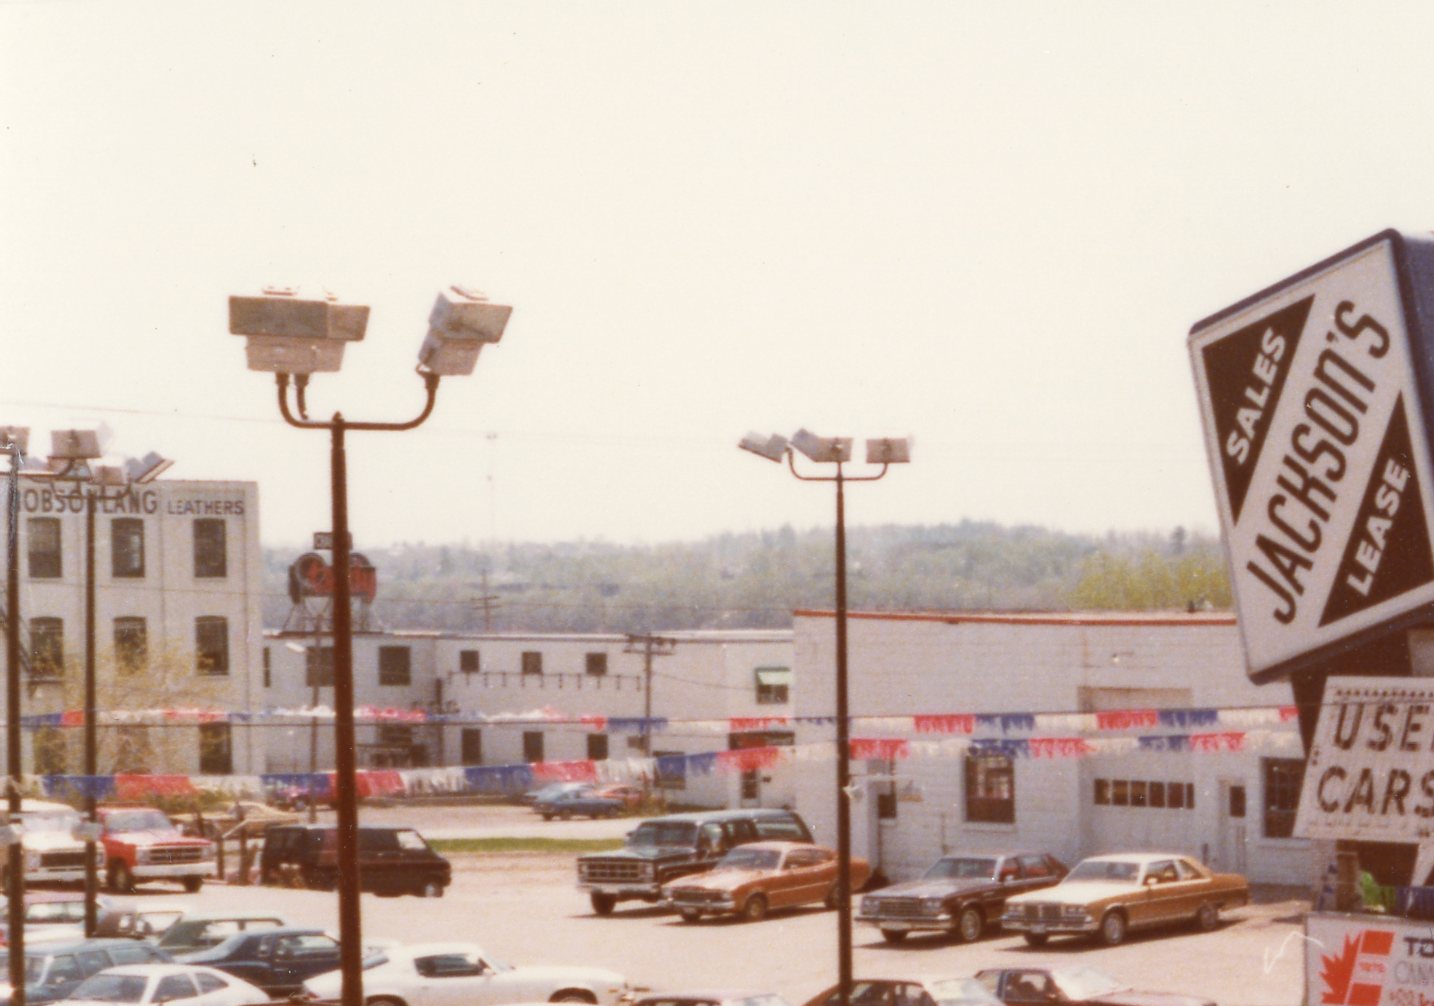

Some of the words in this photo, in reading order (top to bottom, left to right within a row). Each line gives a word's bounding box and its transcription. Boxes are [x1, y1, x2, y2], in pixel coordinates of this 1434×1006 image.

[1226, 326, 1287, 465] SALES
[1245, 300, 1391, 625] JACKSON'S
[167, 499, 244, 515] LEATHERS
[1346, 457, 1409, 597] LEASE
